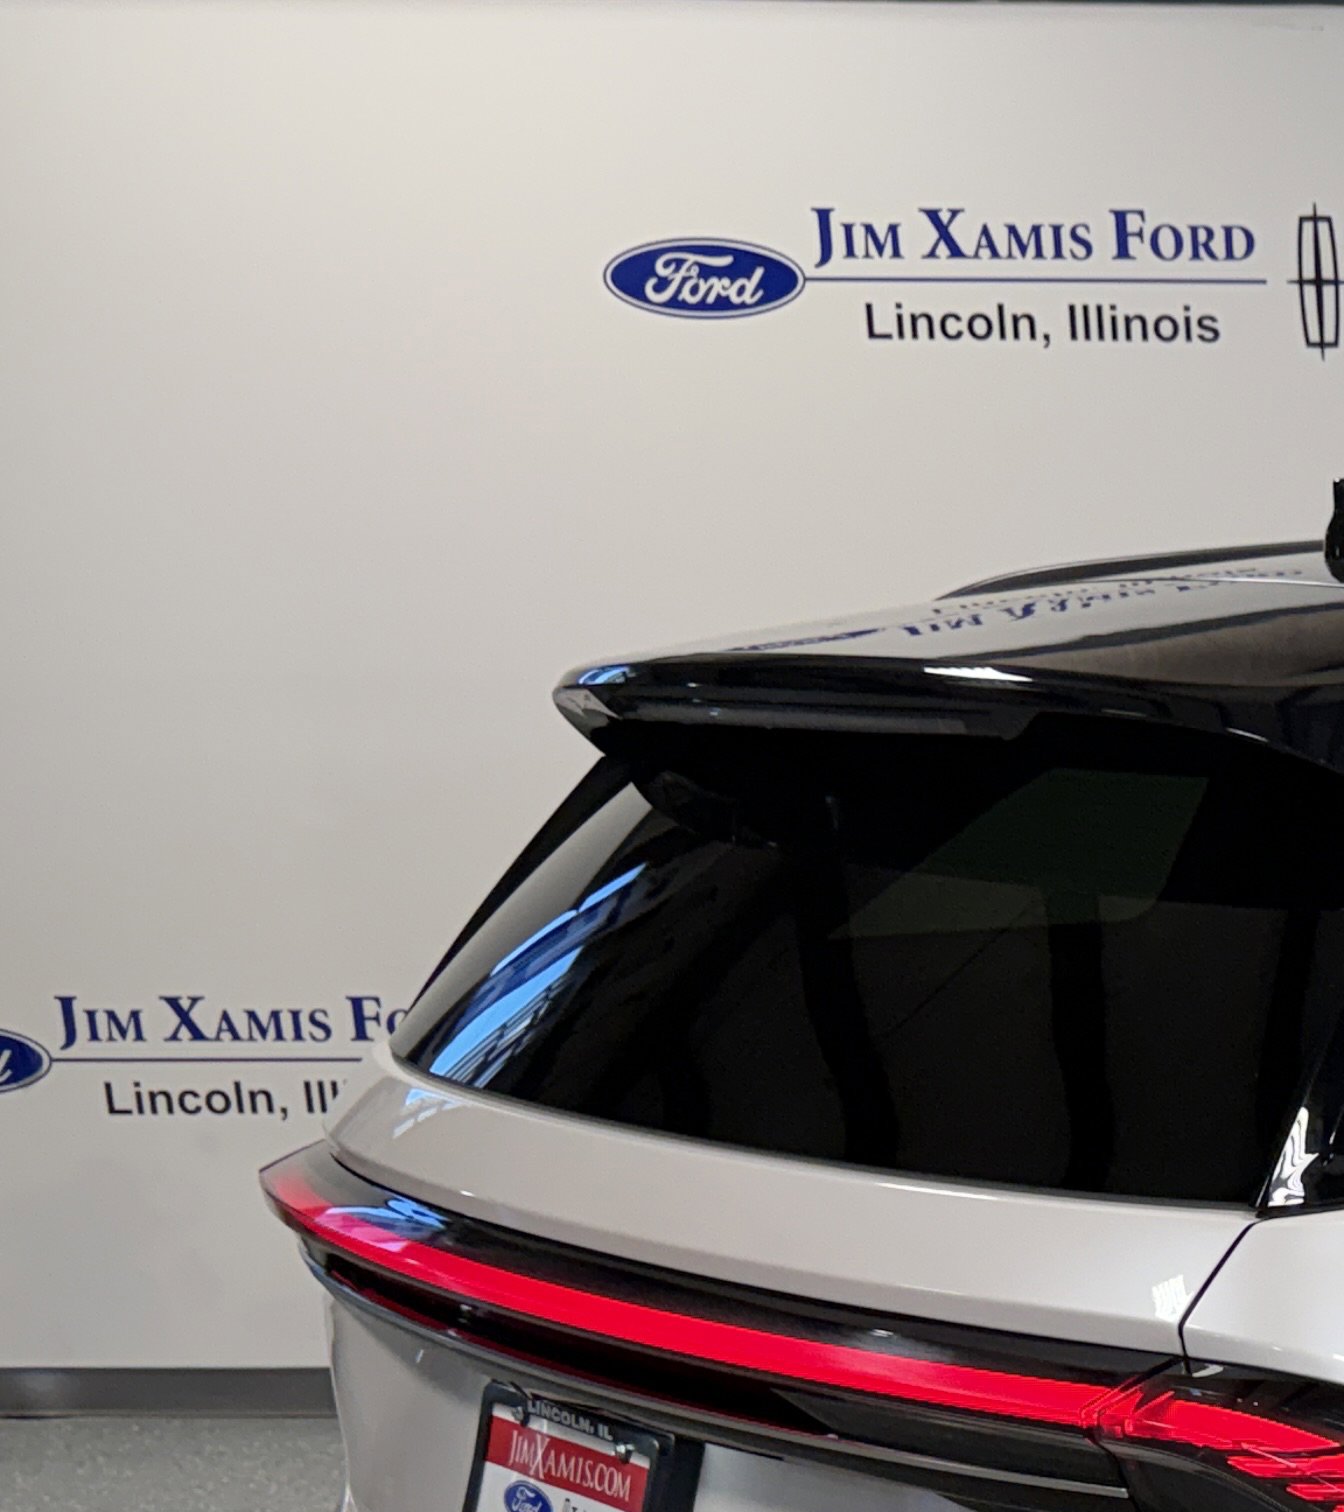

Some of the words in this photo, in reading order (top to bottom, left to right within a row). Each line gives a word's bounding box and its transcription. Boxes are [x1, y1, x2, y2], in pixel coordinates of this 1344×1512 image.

[811, 206, 904, 269] JIM
[918, 207, 1094, 262] XAMIS
[1108, 208, 1256, 262] FORD
[644, 251, 766, 305] Ford
[864, 301, 1052, 349] Lincoln,
[1067, 303, 1221, 344] Illinois
[53, 994, 147, 1050] JIM
[158, 995, 333, 1043] XAMIS
[103, 1080, 289, 1121] Lincoln,
[527, 1398, 595, 1434] LINCOLN,
[597, 1423, 614, 1441] IL
